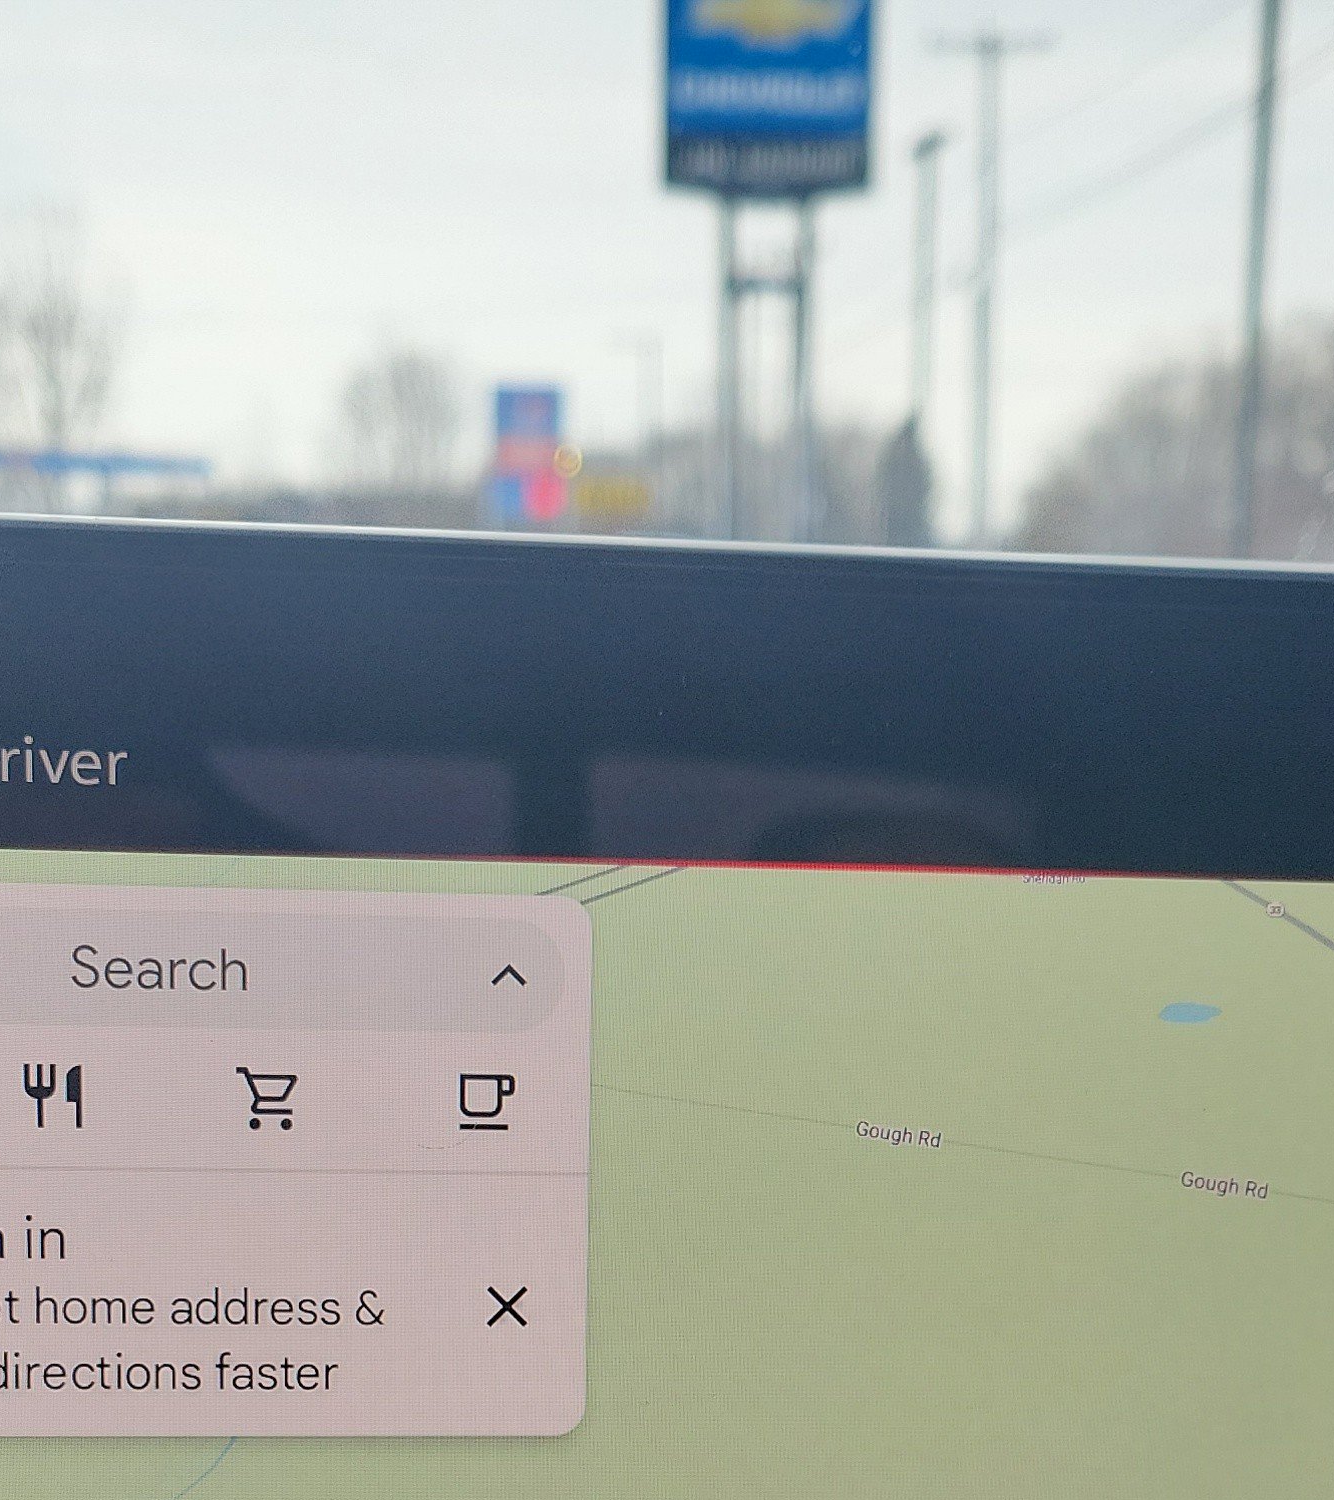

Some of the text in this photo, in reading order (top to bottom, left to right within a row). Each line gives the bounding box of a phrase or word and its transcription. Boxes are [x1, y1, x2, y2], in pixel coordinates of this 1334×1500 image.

[71, 944, 248, 991] Search
[856, 1120, 942, 1149] Gough Rd
[1181, 1171, 1269, 1199] Gough Rd
[25, 1214, 65, 1259] in
[35, 1286, 155, 1325] home
[171, 1287, 341, 1326] address
[355, 1290, 385, 1326] &
[215, 1352, 339, 1391] faster
